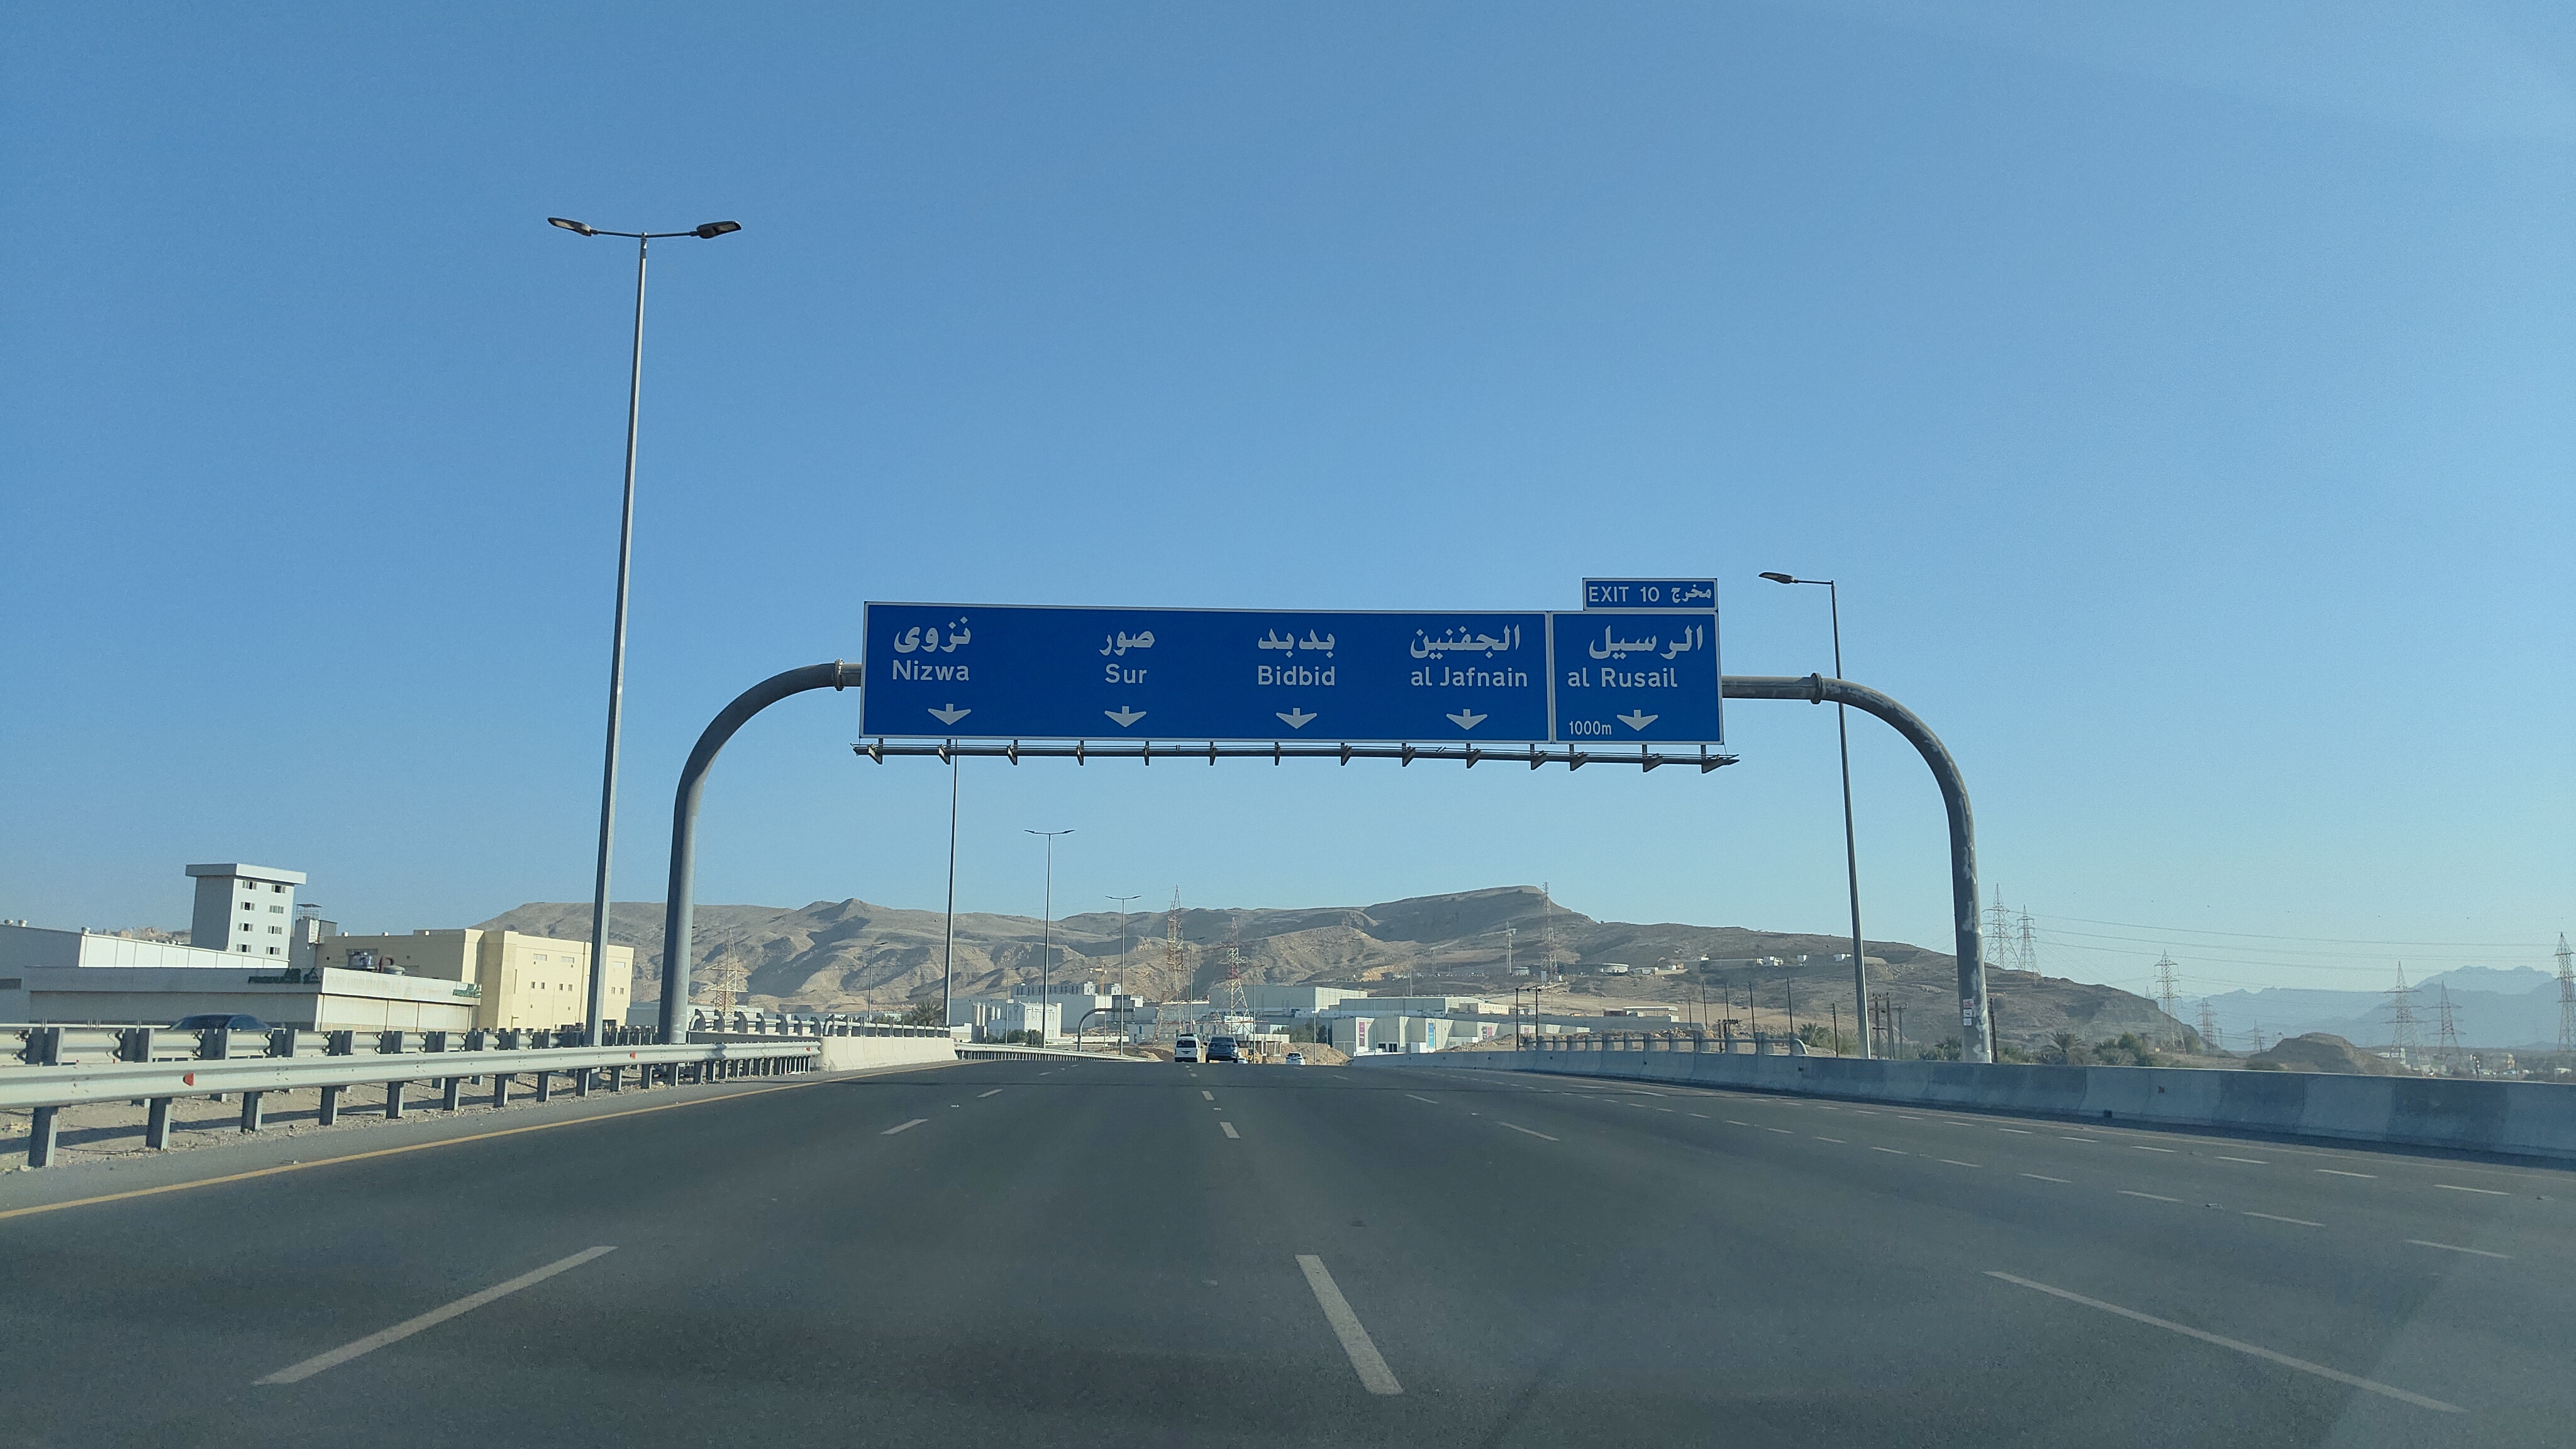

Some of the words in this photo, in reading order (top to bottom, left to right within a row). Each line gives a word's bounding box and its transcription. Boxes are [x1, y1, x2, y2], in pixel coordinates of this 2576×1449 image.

[1588, 586, 1629, 602] EXIT
[1640, 586, 1660, 602] 10
[1670, 582, 1712, 604] مخرج
[1099, 630, 1156, 657] صور
[1257, 628, 1336, 658] بدبد
[1409, 623, 1520, 659] الجفنين
[1588, 625, 1704, 660] الرسيل
[892, 659, 970, 681] Nizwa
[1104, 663, 1148, 684] Sur
[1257, 665, 1336, 686] Bidbid
[1410, 667, 1433, 687] al
[1439, 667, 1528, 687] Jafnain
[1567, 667, 1590, 687] al
[1601, 667, 1679, 688] Rusail
[1568, 720, 1613, 736] 1000m
